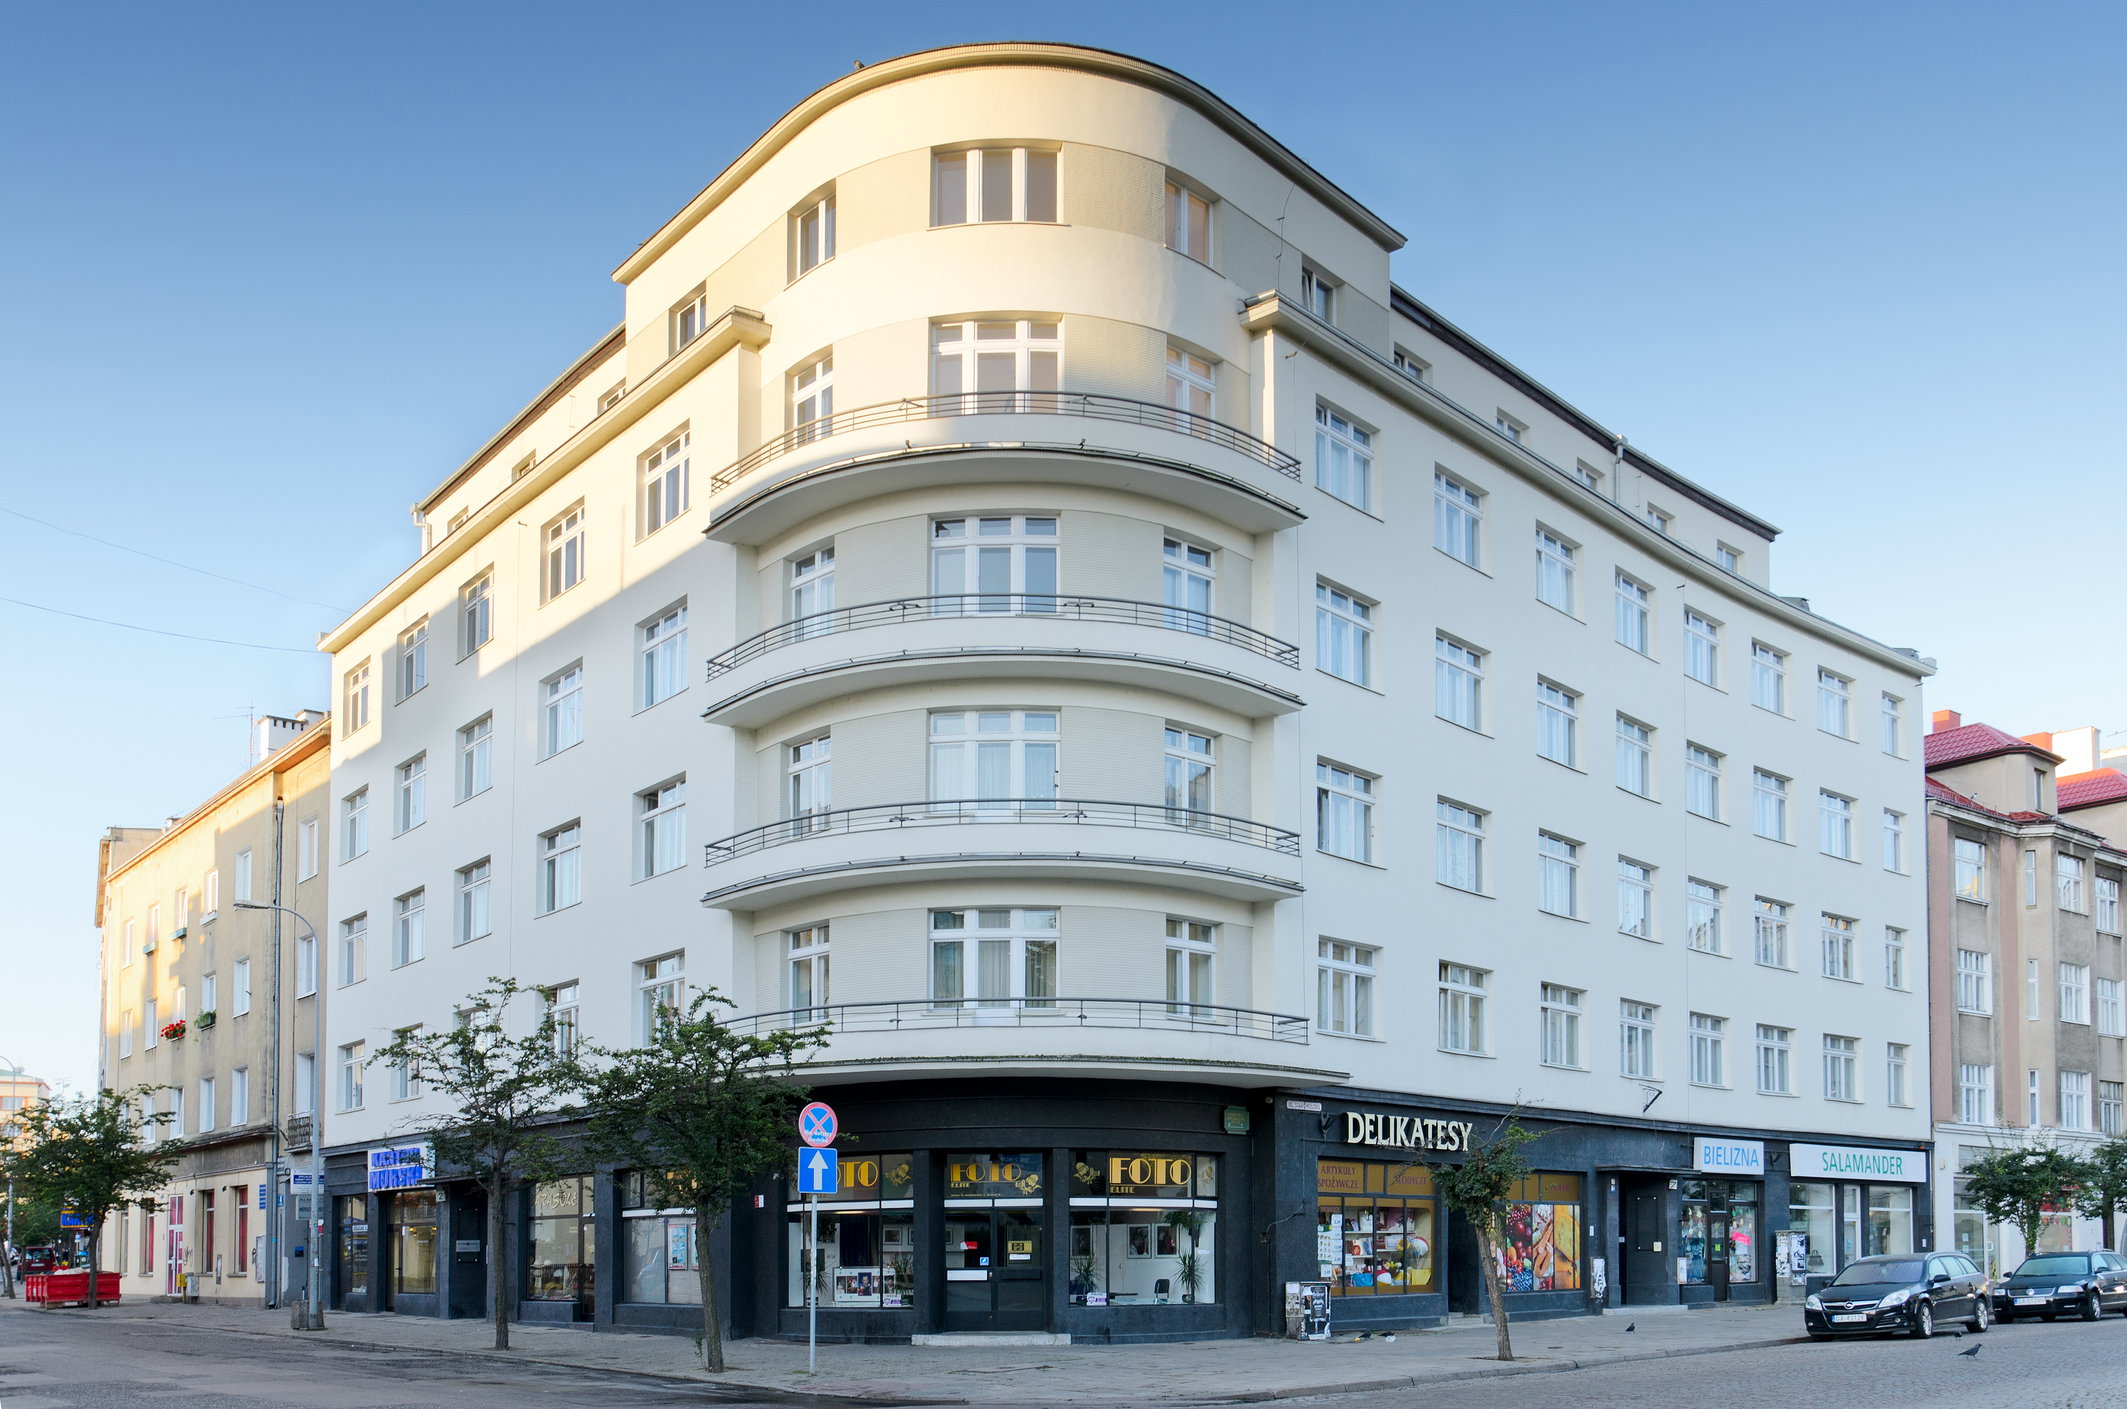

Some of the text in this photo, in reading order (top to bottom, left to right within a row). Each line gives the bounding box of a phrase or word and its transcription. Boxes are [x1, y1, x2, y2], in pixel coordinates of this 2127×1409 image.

[1346, 1111, 1473, 1152] DELIKATESY
[1703, 1145, 1760, 1168] BIELIZNA
[1822, 1151, 1903, 1176] SALAMANDER
[837, 1160, 879, 1187] TO
[950, 1163, 1022, 1182] FOTO
[1109, 1157, 1192, 1185] FOTO
[1317, 1176, 1359, 1189] SPOŻYWCZE
[1109, 1186, 1136, 1194] ELITE
